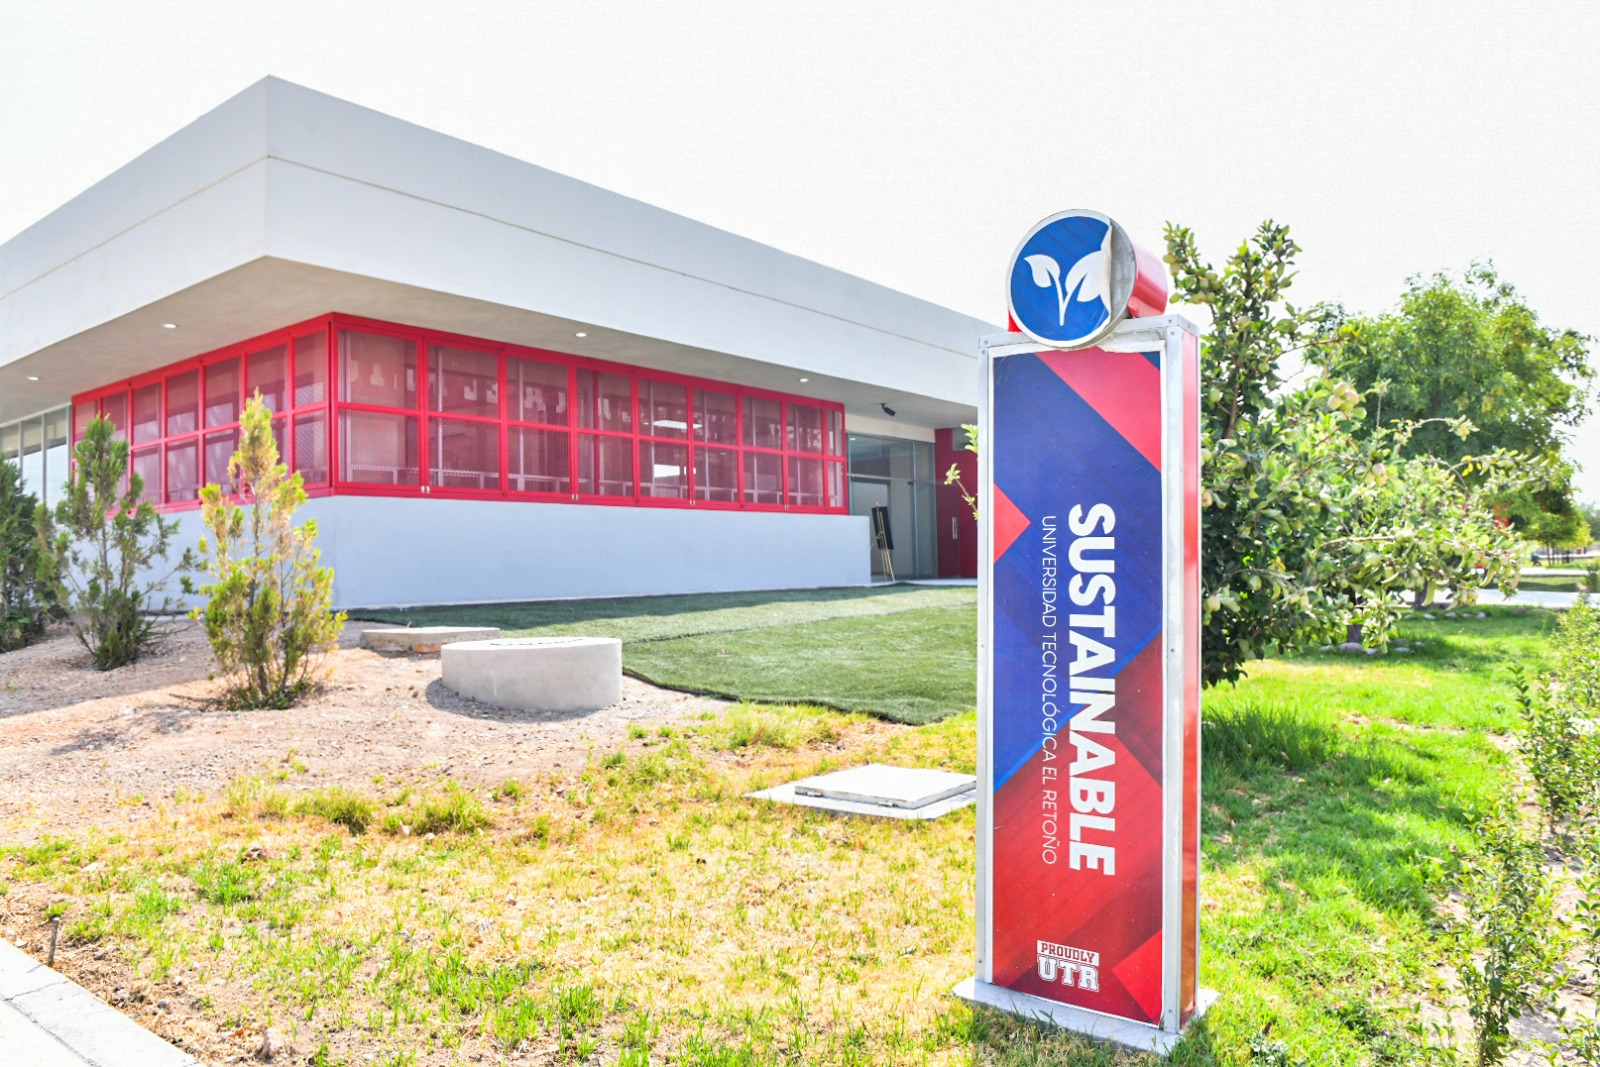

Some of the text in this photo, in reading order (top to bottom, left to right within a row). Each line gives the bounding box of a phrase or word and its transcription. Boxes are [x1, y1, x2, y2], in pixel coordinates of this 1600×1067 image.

[1041, 515, 1060, 865] UNIVERSIDAD TECNOLÓGICA EL RETOÑO
[1068, 503, 1116, 876] SUSTAINABLE
[1037, 953, 1099, 992] UTR
[1040, 942, 1096, 964] PROUDLY
